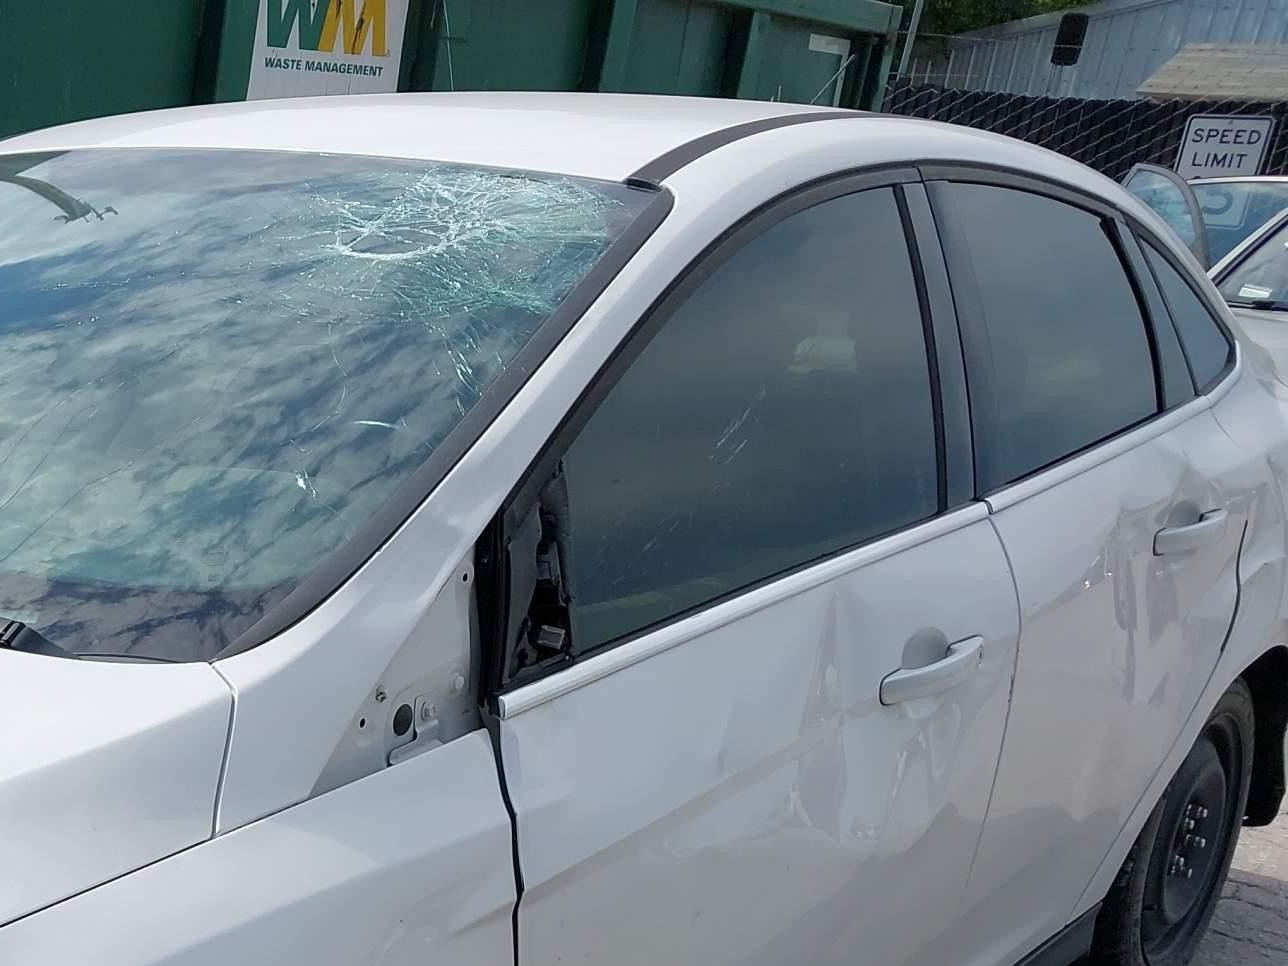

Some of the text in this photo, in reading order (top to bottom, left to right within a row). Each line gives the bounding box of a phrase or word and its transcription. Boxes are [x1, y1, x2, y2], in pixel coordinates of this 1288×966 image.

[266, 0, 387, 56] WM
[264, 57, 384, 77] WASTE MANAGEMENT
[1192, 128, 1262, 145] SPEED
[1192, 152, 1248, 169] LIMIT
